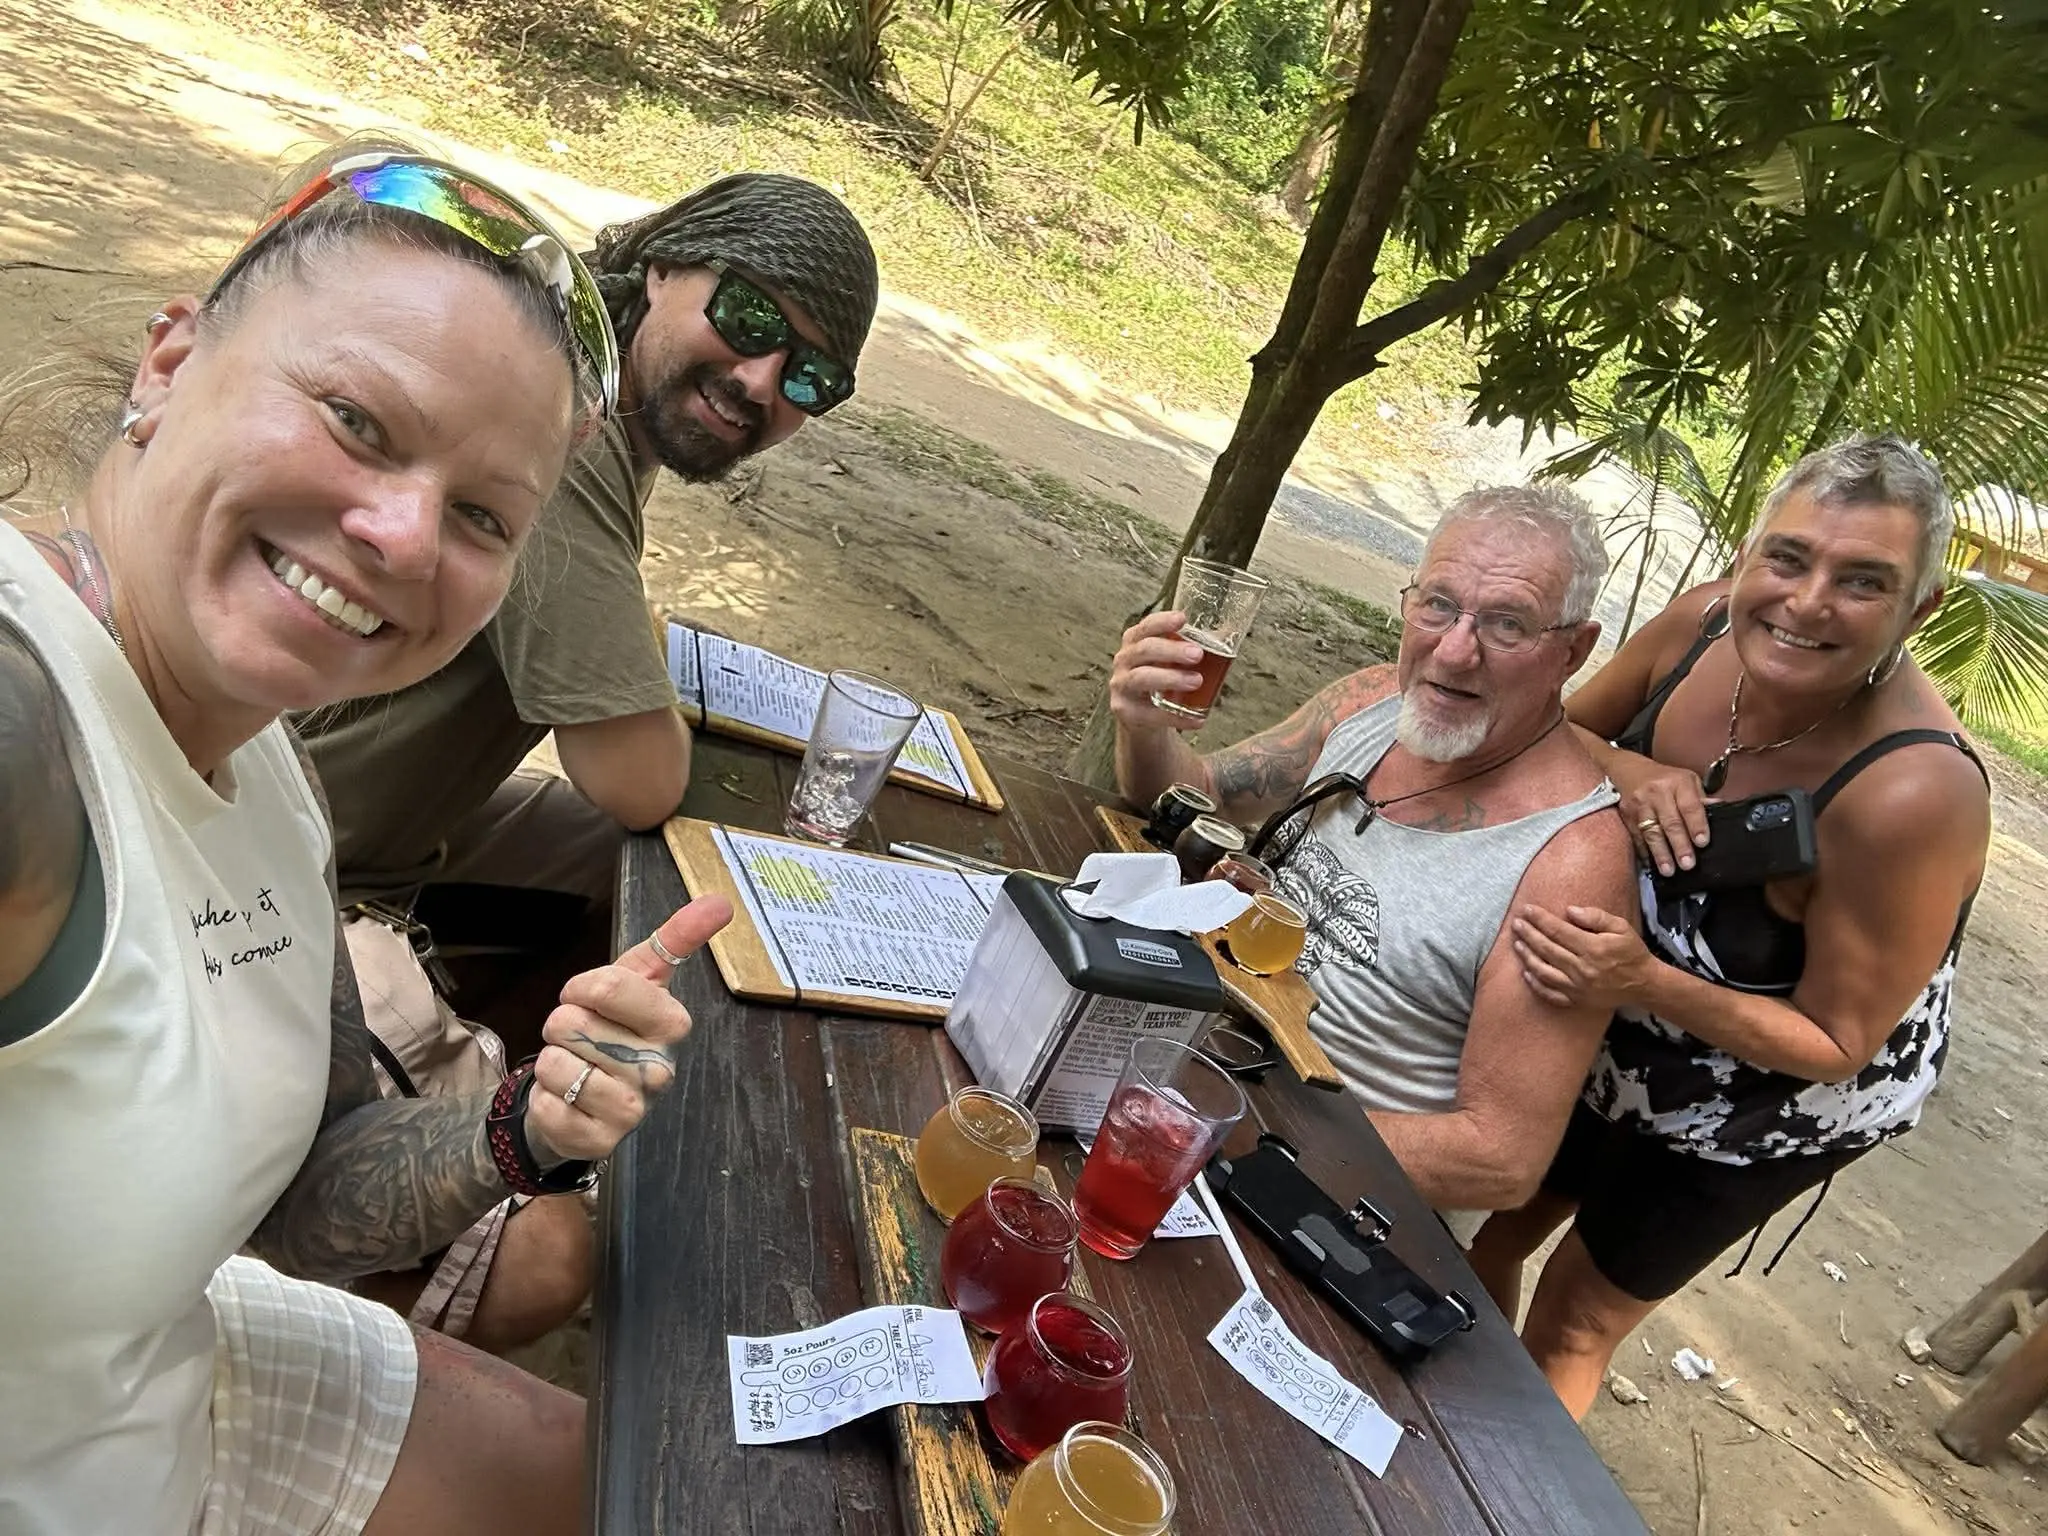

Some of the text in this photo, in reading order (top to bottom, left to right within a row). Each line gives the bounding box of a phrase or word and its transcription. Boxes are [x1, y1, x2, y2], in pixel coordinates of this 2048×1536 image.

[256, 887, 281, 917] et
[1145, 1011, 1168, 1021] HEY
[1168, 1011, 1192, 1021] YOU!
[805, 1336, 837, 1352] Pours
